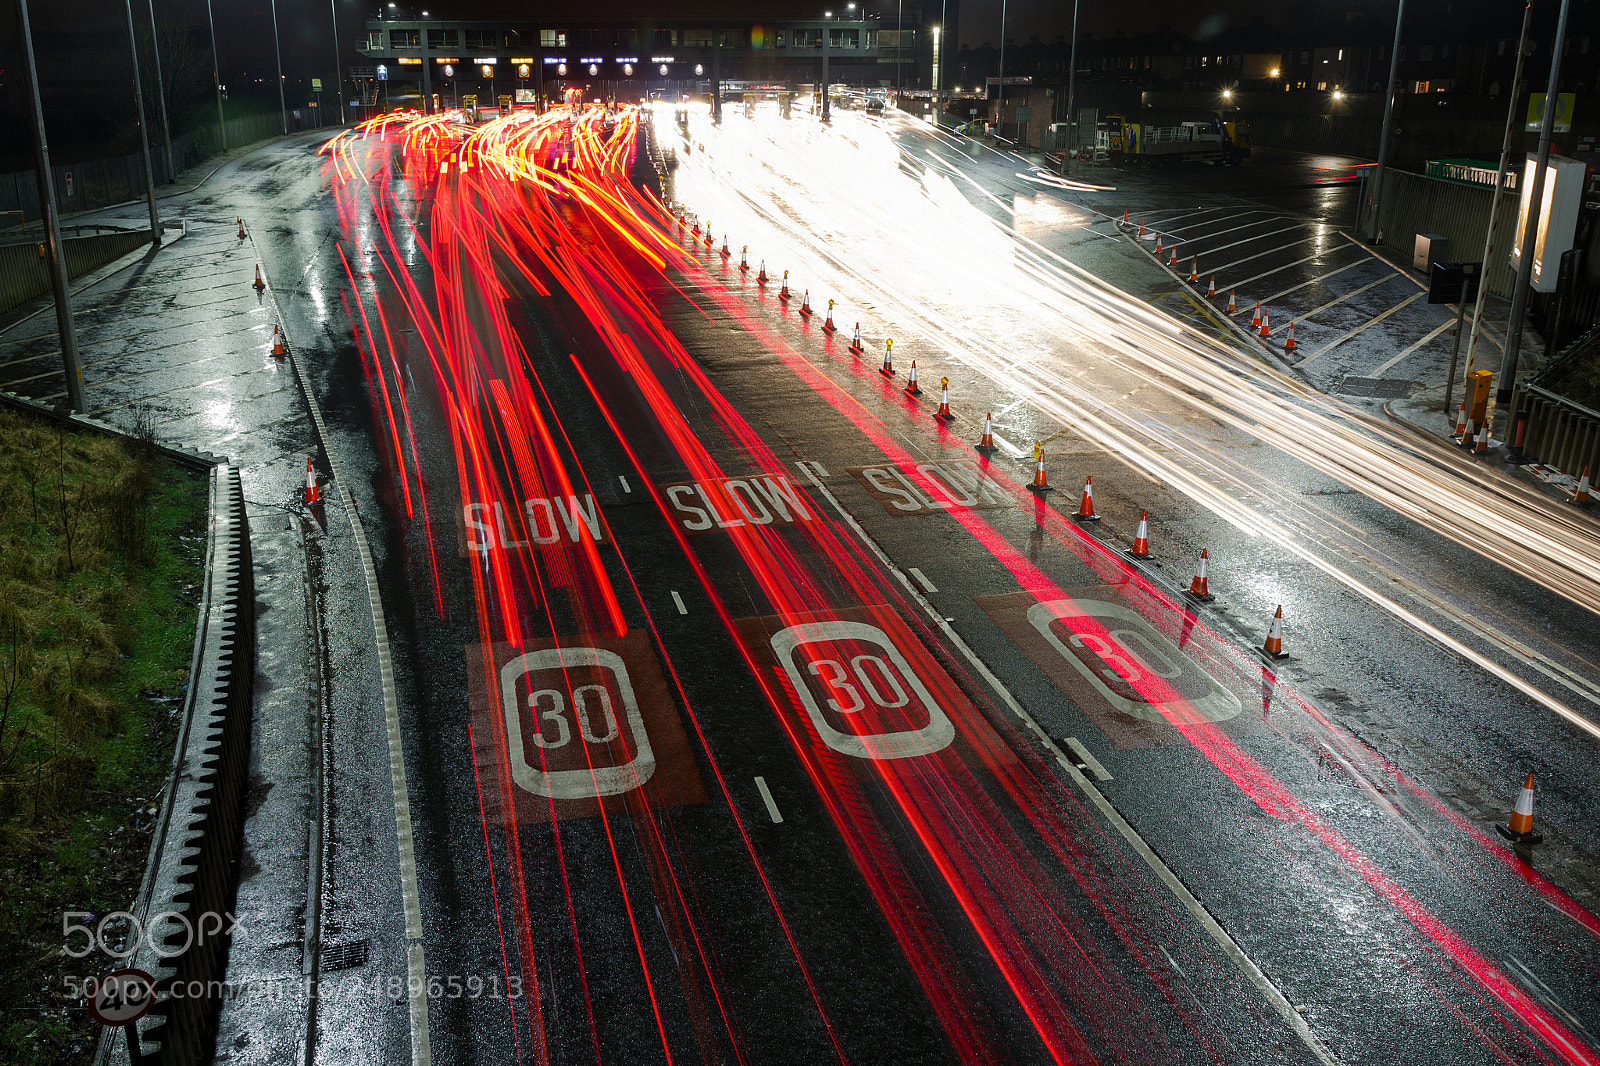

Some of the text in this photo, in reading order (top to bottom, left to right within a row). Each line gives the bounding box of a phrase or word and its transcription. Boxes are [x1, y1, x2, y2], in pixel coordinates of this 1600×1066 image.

[666, 475, 812, 531] SLOW
[862, 459, 1017, 513] SLOW
[463, 494, 604, 551] SLOW
[1069, 628, 1183, 682] 30
[808, 654, 911, 714] 30
[527, 684, 619, 749] 30
[99, 983, 148, 1011] 40
